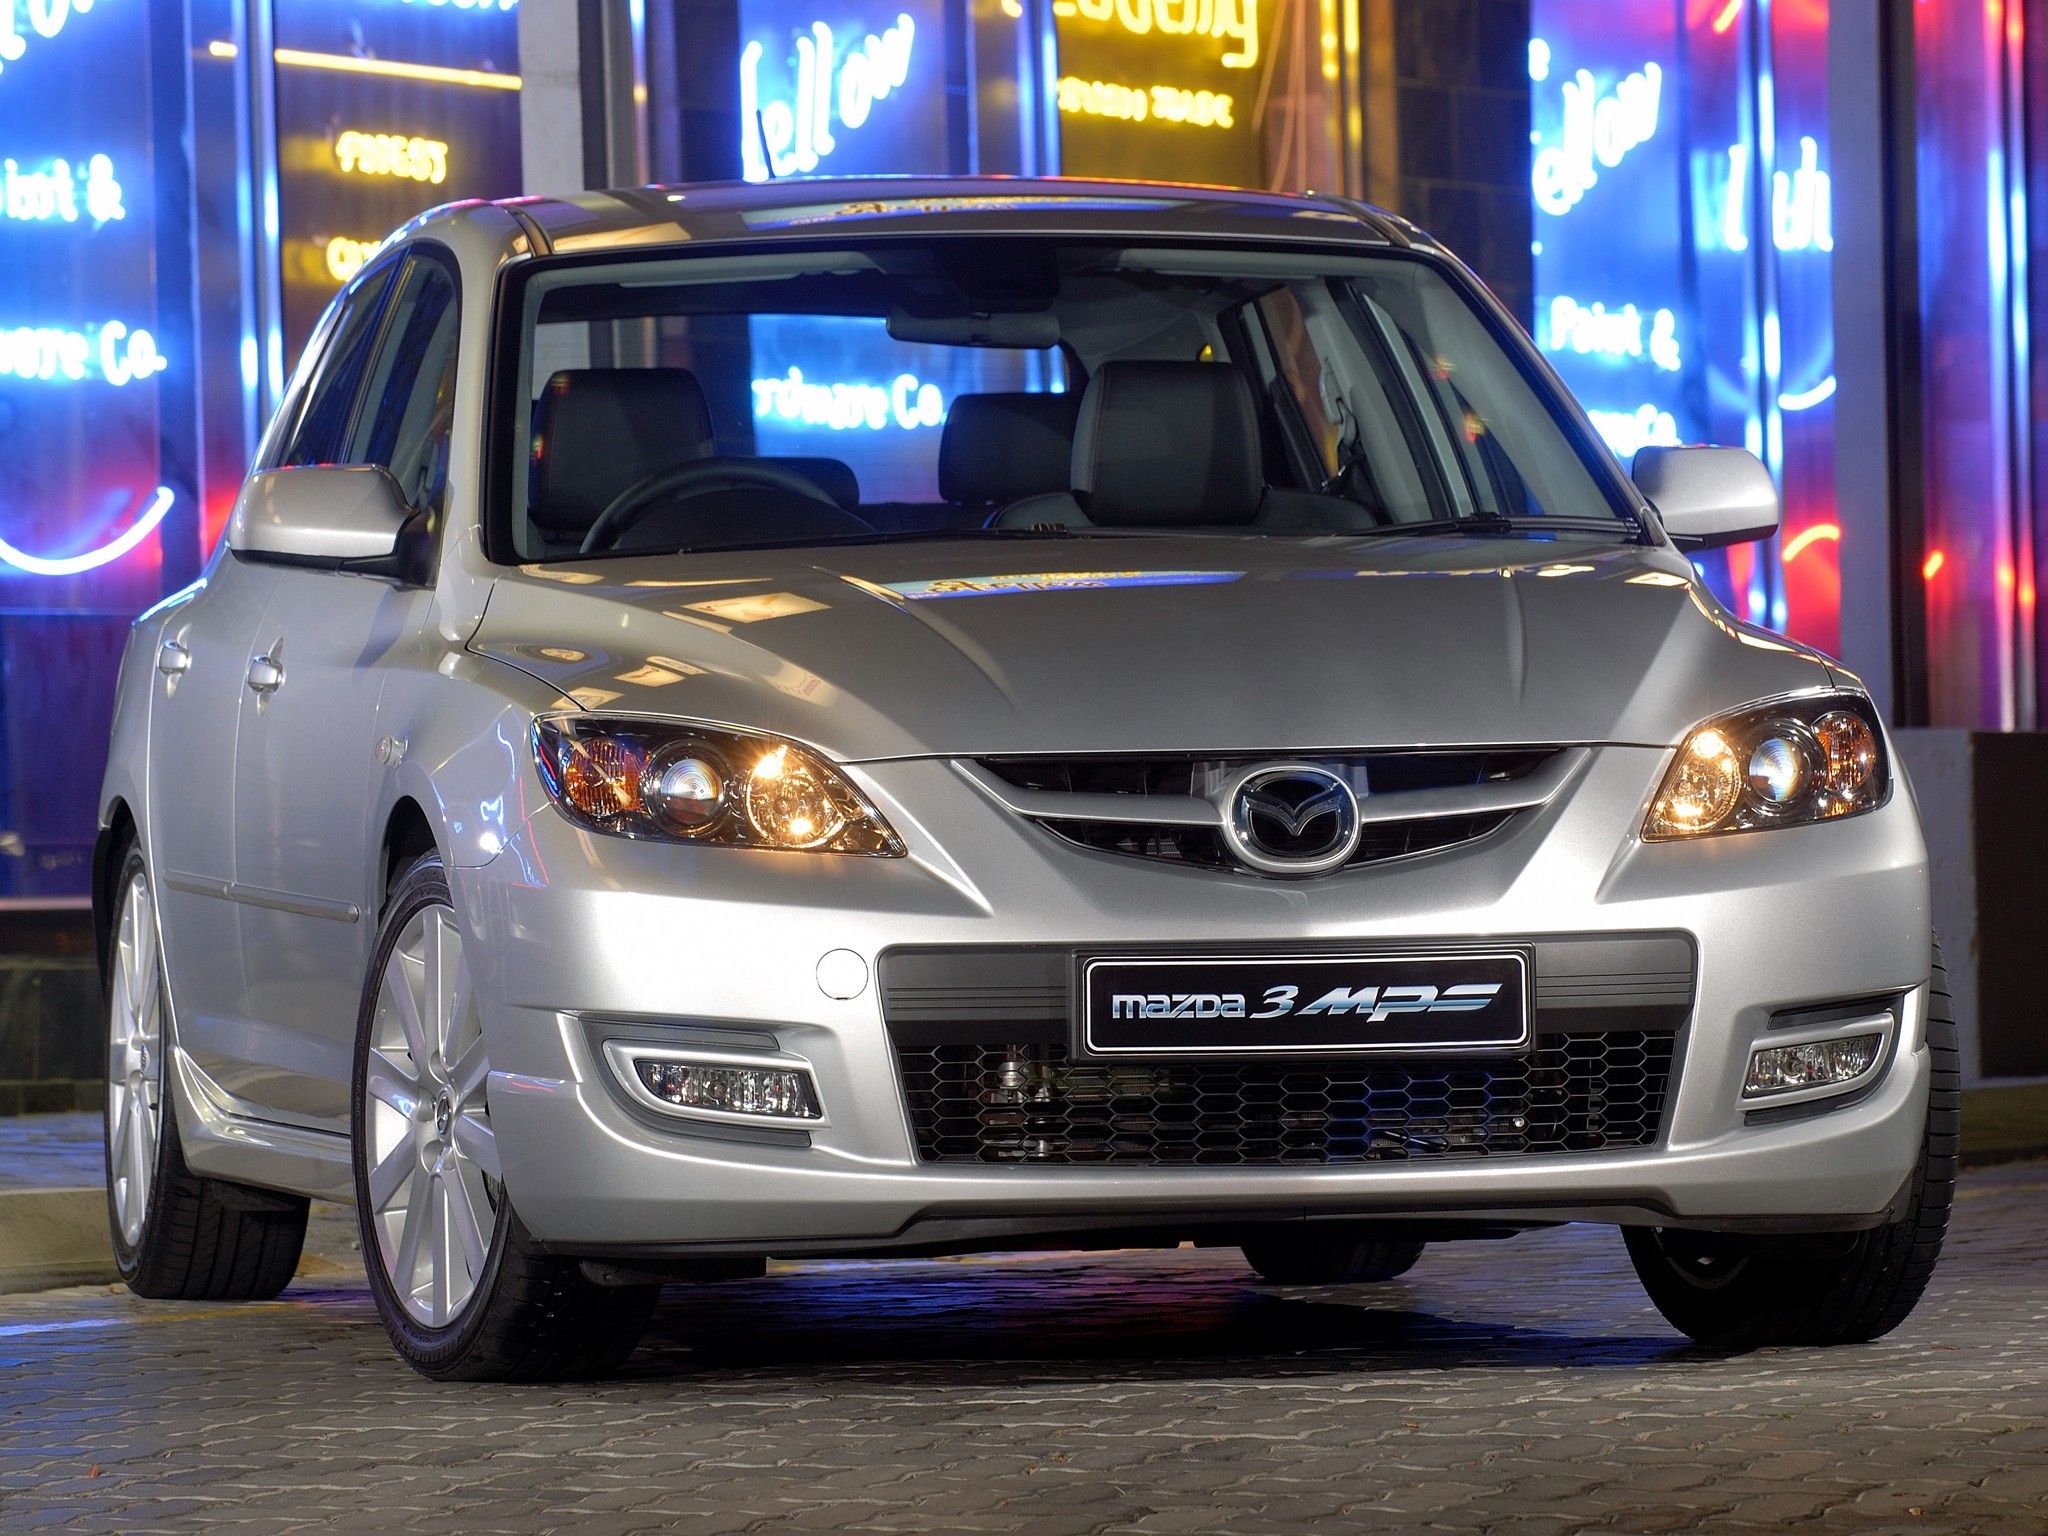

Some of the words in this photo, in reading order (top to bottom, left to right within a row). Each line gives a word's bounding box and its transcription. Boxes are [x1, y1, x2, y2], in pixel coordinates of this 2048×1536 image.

[1531, 38, 1662, 216] ellow
[100, 319, 168, 387] Co.
[1112, 993, 1246, 1019] mazda
[1249, 984, 1299, 1019] 3
[1294, 983, 1503, 1023] MPS
